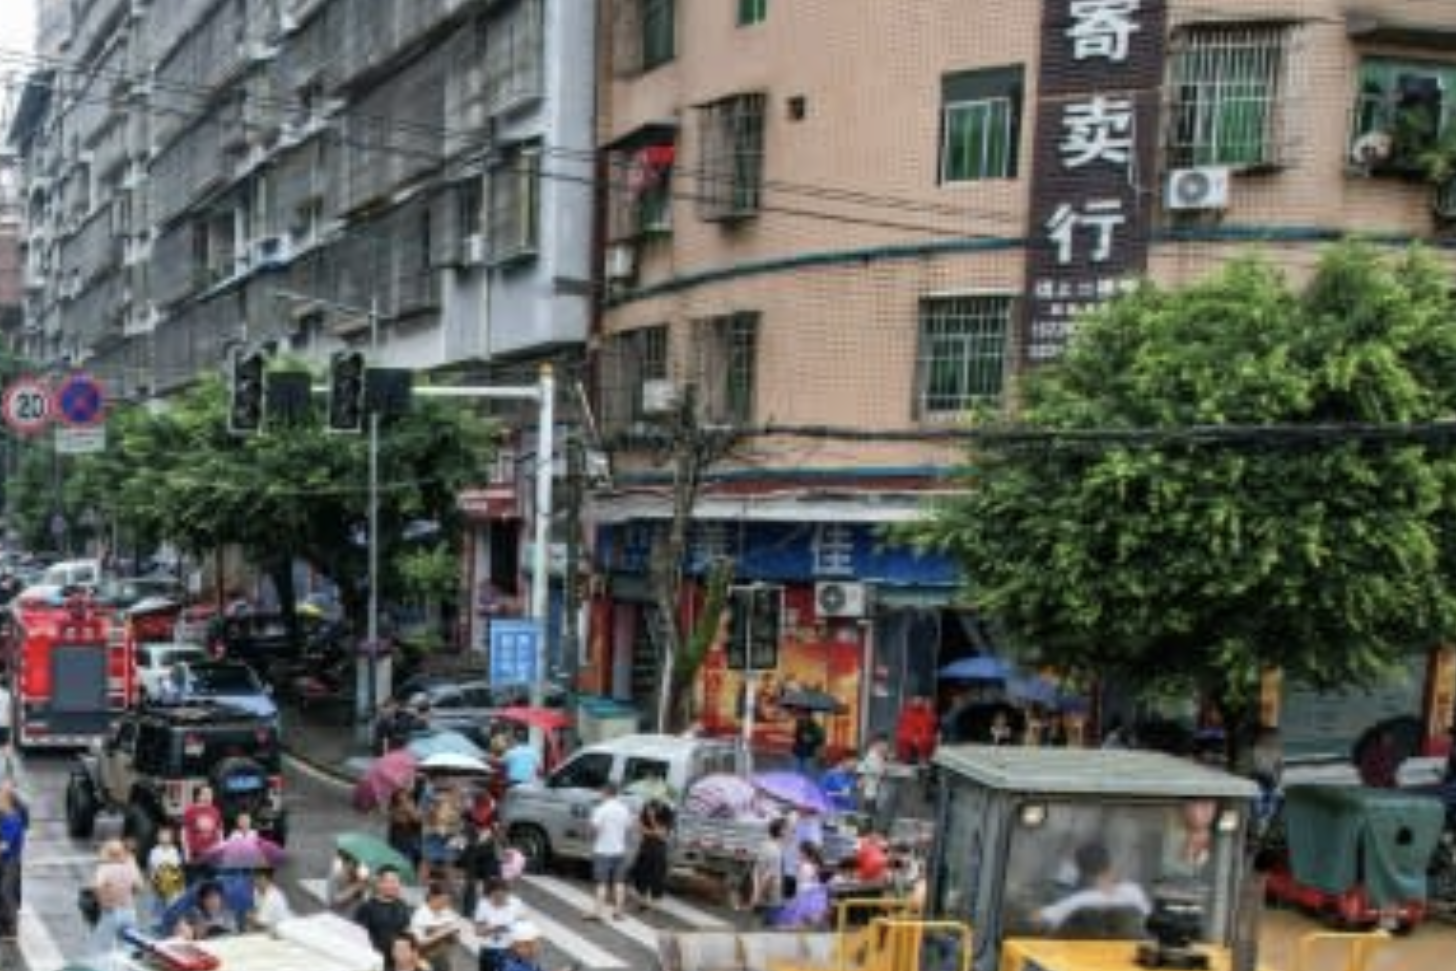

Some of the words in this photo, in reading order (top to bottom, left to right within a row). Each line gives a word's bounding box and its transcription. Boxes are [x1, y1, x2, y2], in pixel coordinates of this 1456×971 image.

[1046, 0, 1142, 264] 寄卖行
[17, 394, 44, 419] 20
